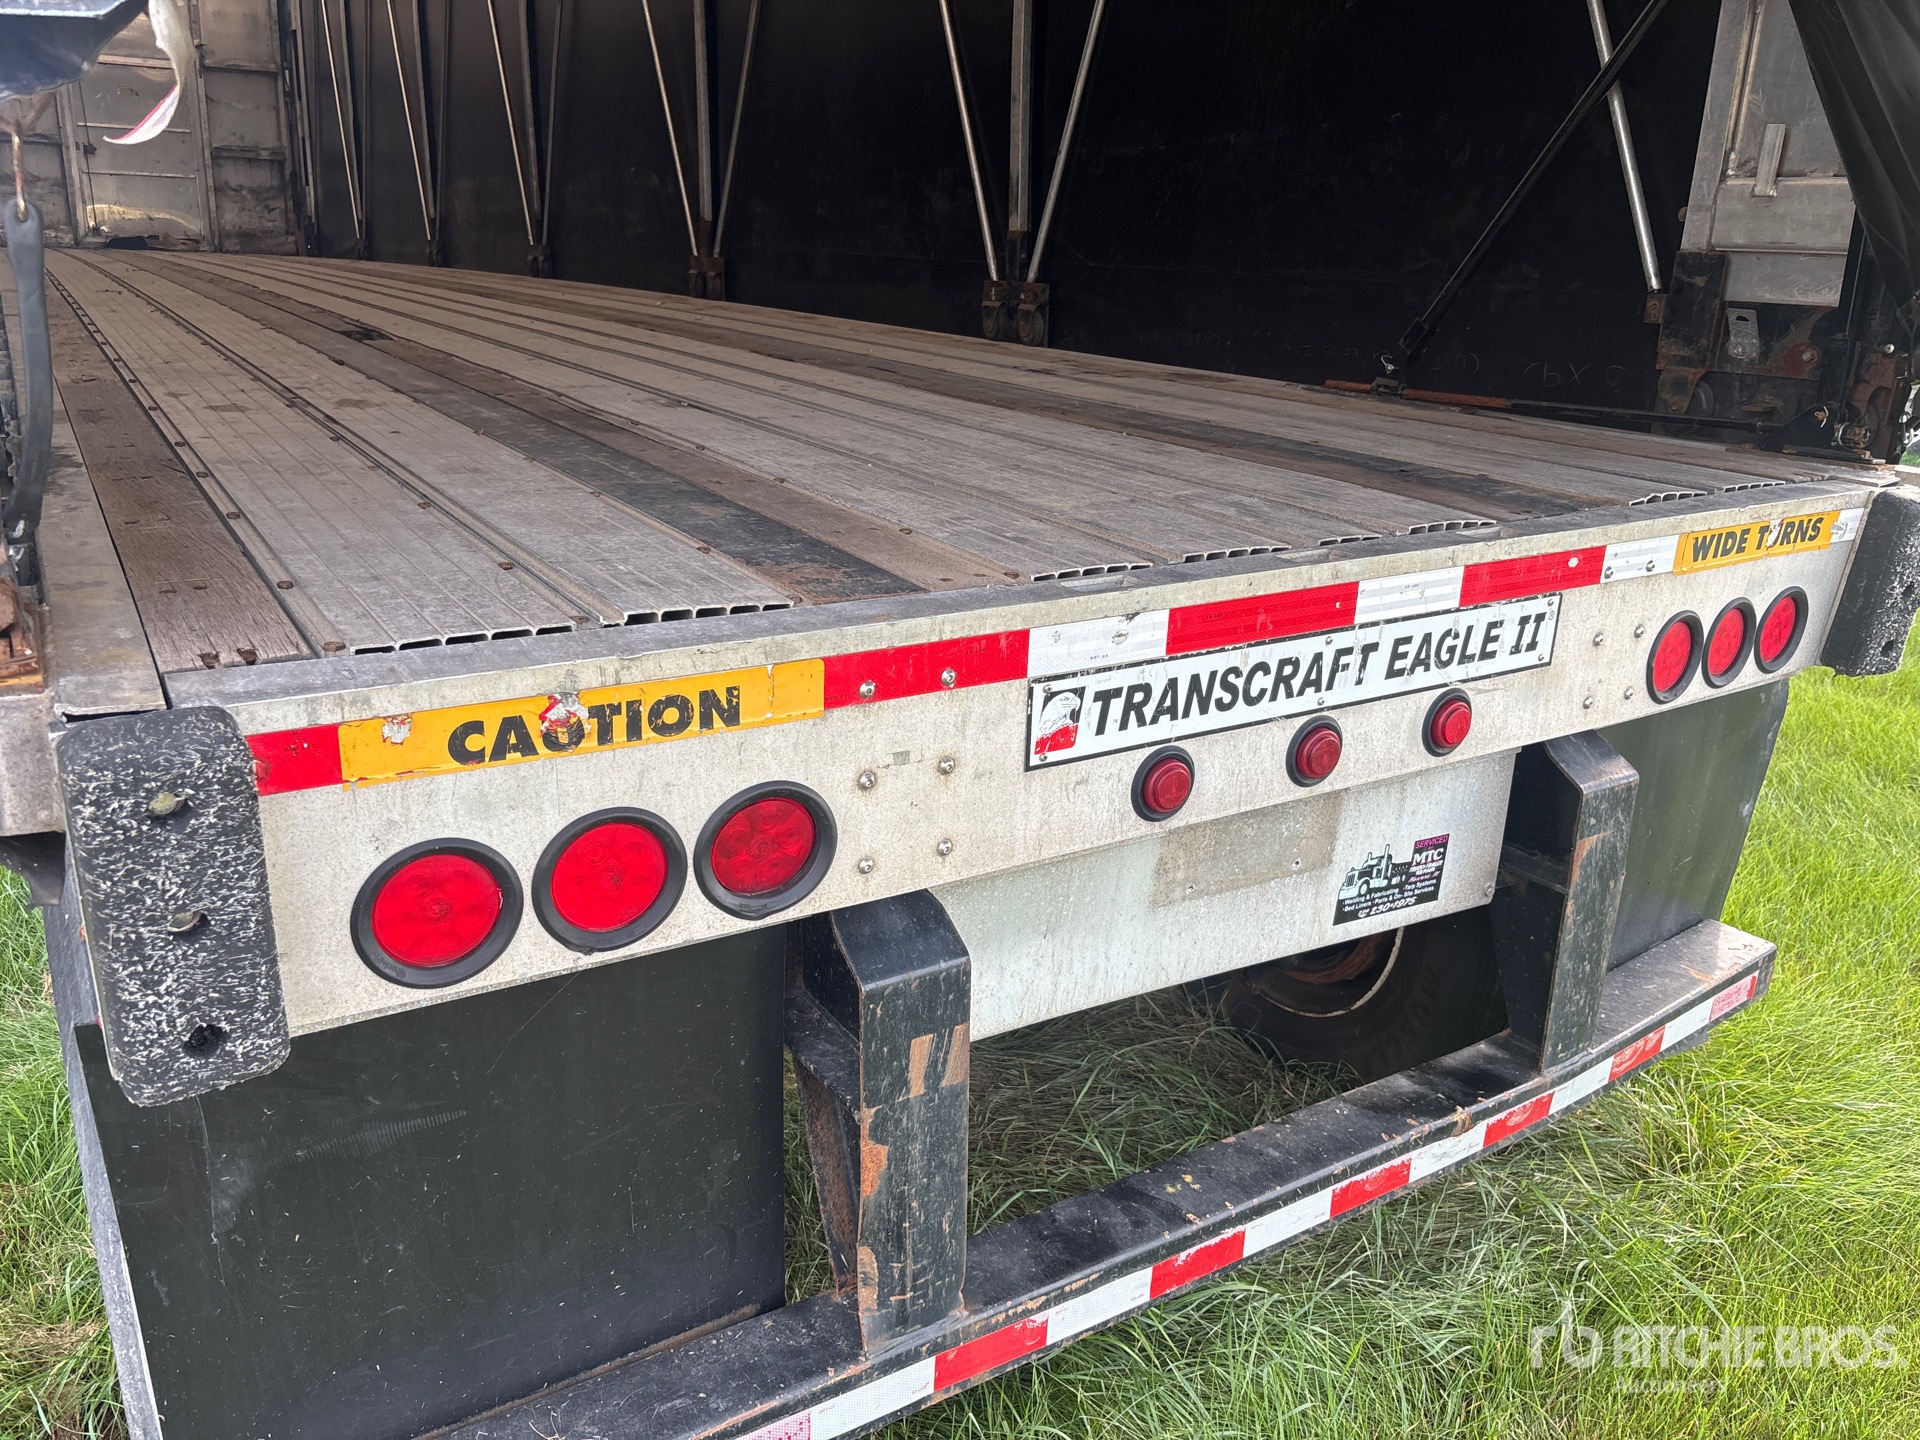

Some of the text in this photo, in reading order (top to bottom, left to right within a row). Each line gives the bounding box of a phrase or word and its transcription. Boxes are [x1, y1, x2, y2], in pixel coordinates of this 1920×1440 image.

[1692, 528, 1749, 562] WIDE
[1092, 611, 1547, 736] TRANSCRAFT EAGLE II
[1415, 835, 1449, 849] SERVICED
[1411, 847, 1444, 867] MTC
[1416, 879, 1436, 888] Systems
[1371, 887, 1399, 899] Fabricating
[1413, 886, 1434, 895] Services
[1355, 902, 1371, 910] Liners
